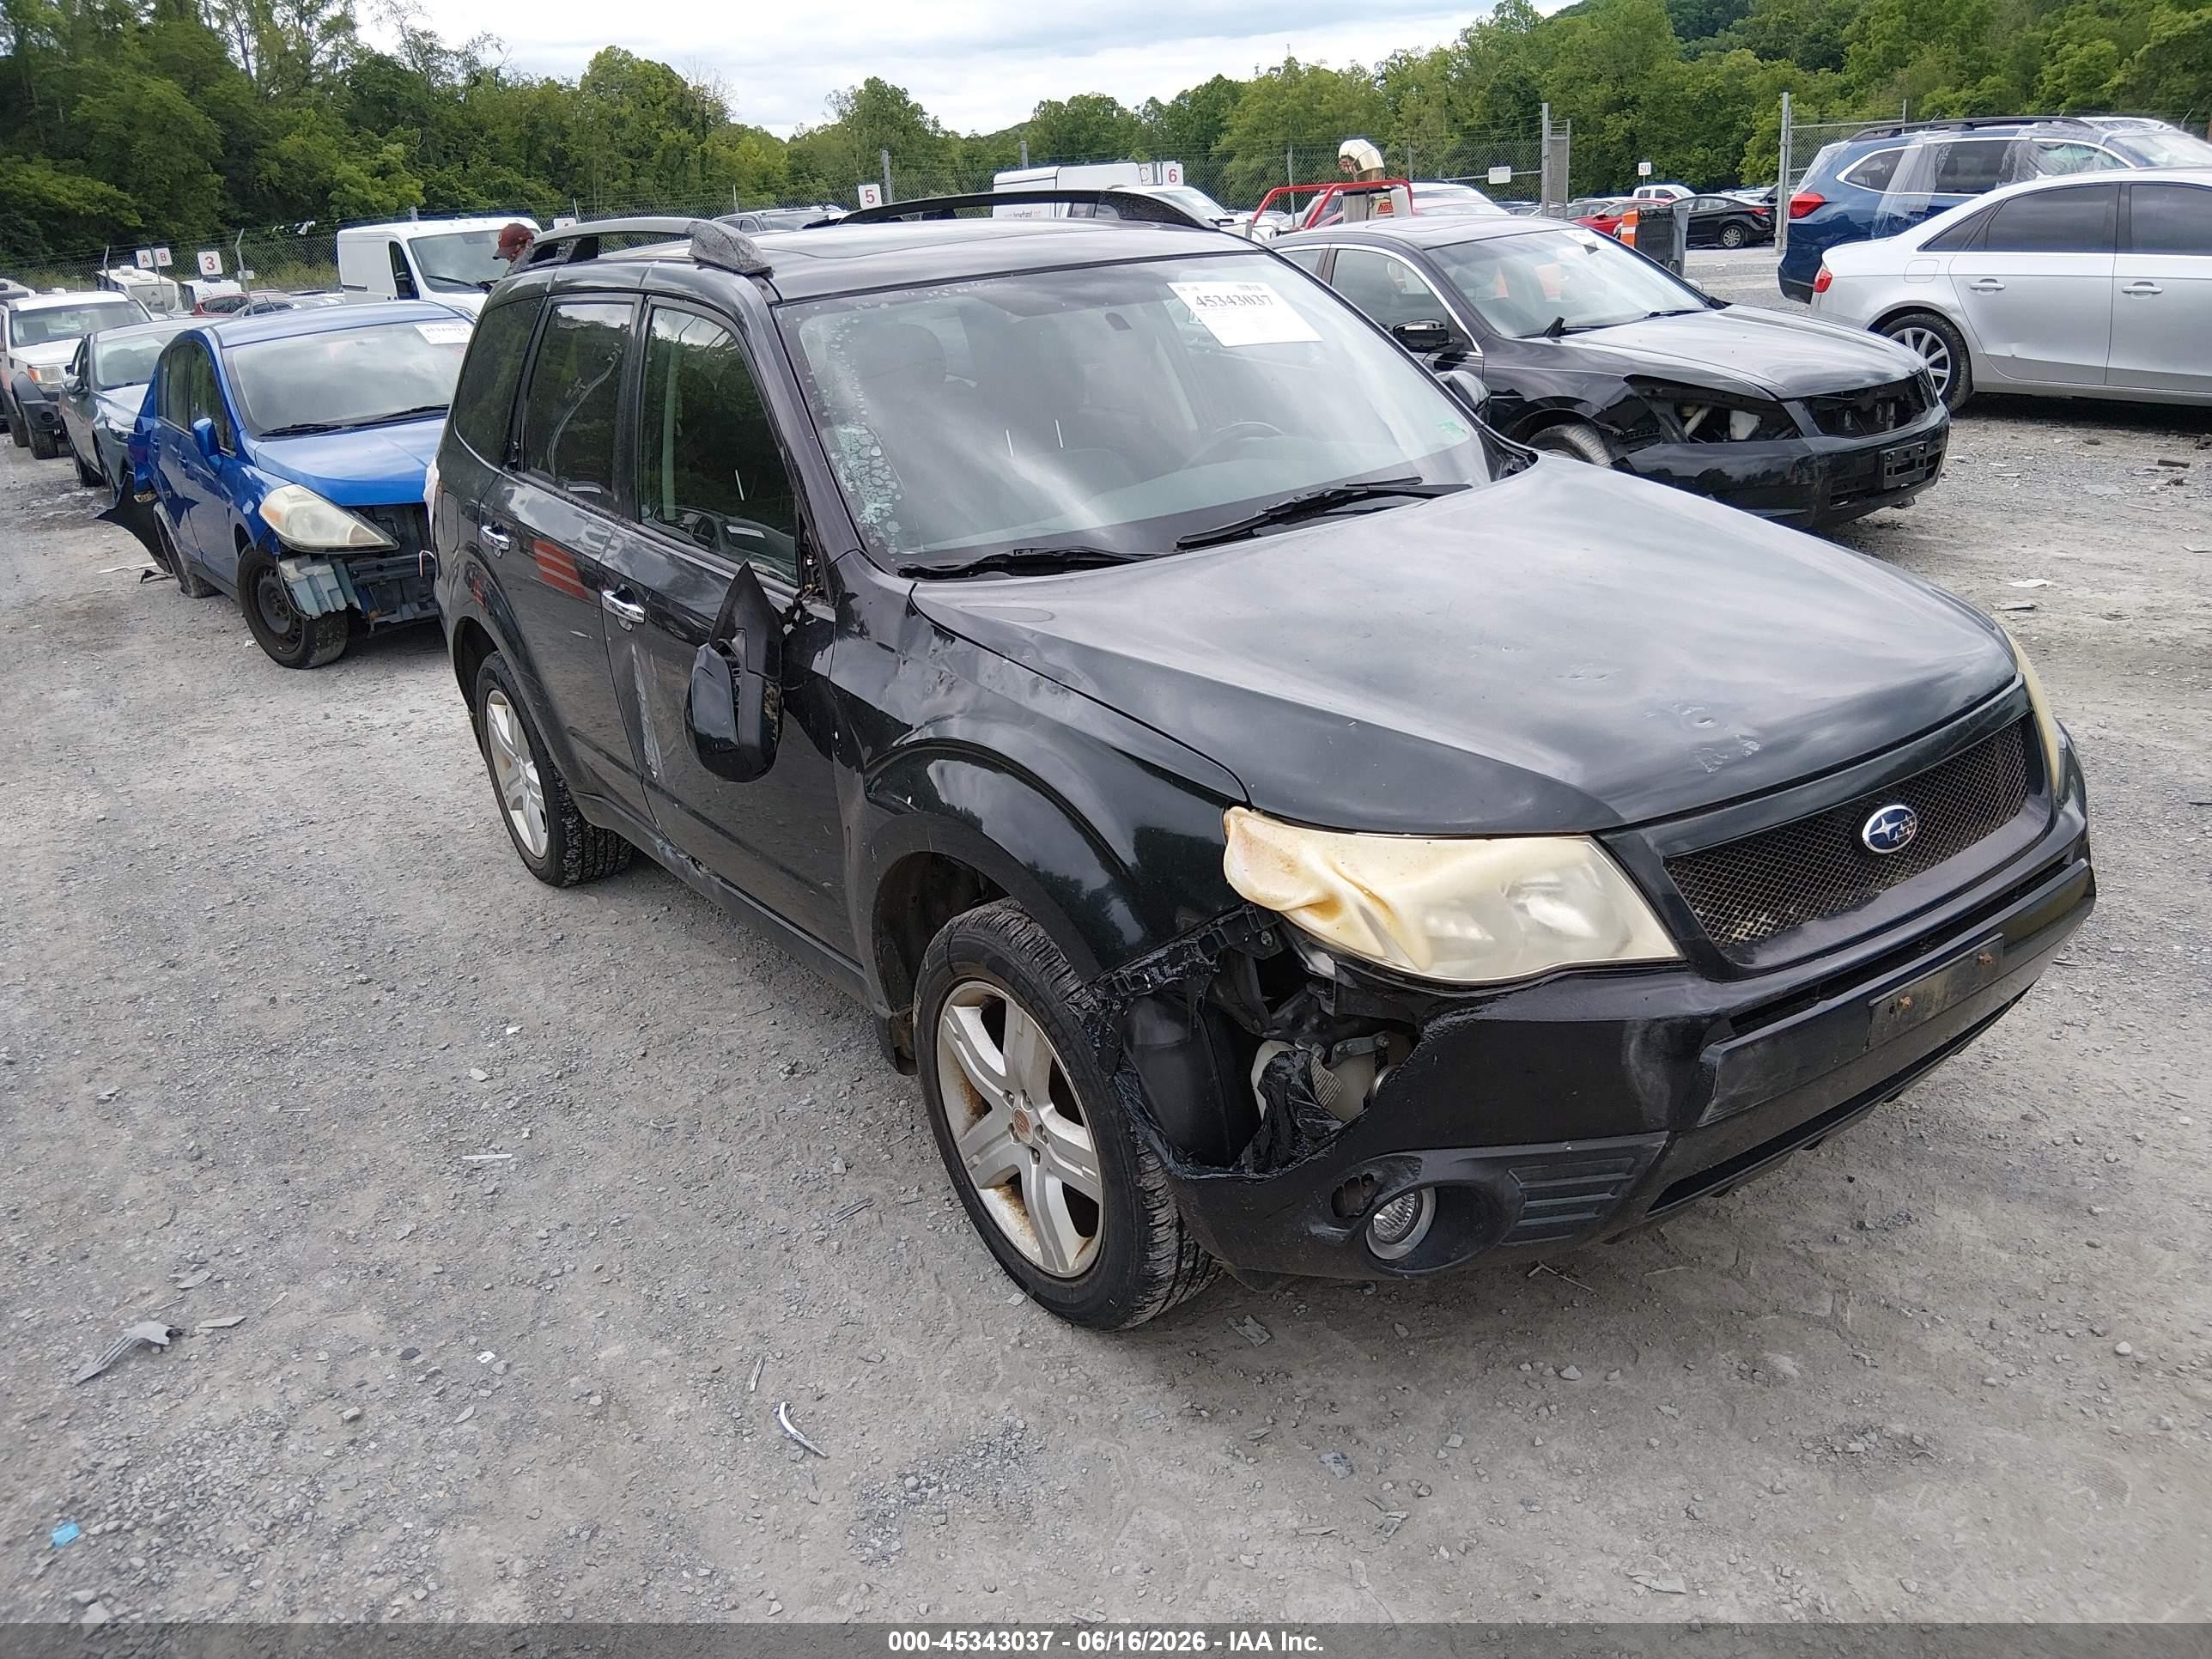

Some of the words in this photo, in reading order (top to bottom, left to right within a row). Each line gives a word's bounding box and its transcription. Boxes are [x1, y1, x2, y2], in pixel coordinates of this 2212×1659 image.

[1640, 164, 1650, 173] 50
[1168, 168, 1178, 183] 6
[865, 189, 875, 204] 5
[142, 254, 149, 264] A
[159, 252, 167, 262] B
[204, 256, 216, 270] 3
[1195, 295, 1273, 307] 45343037
